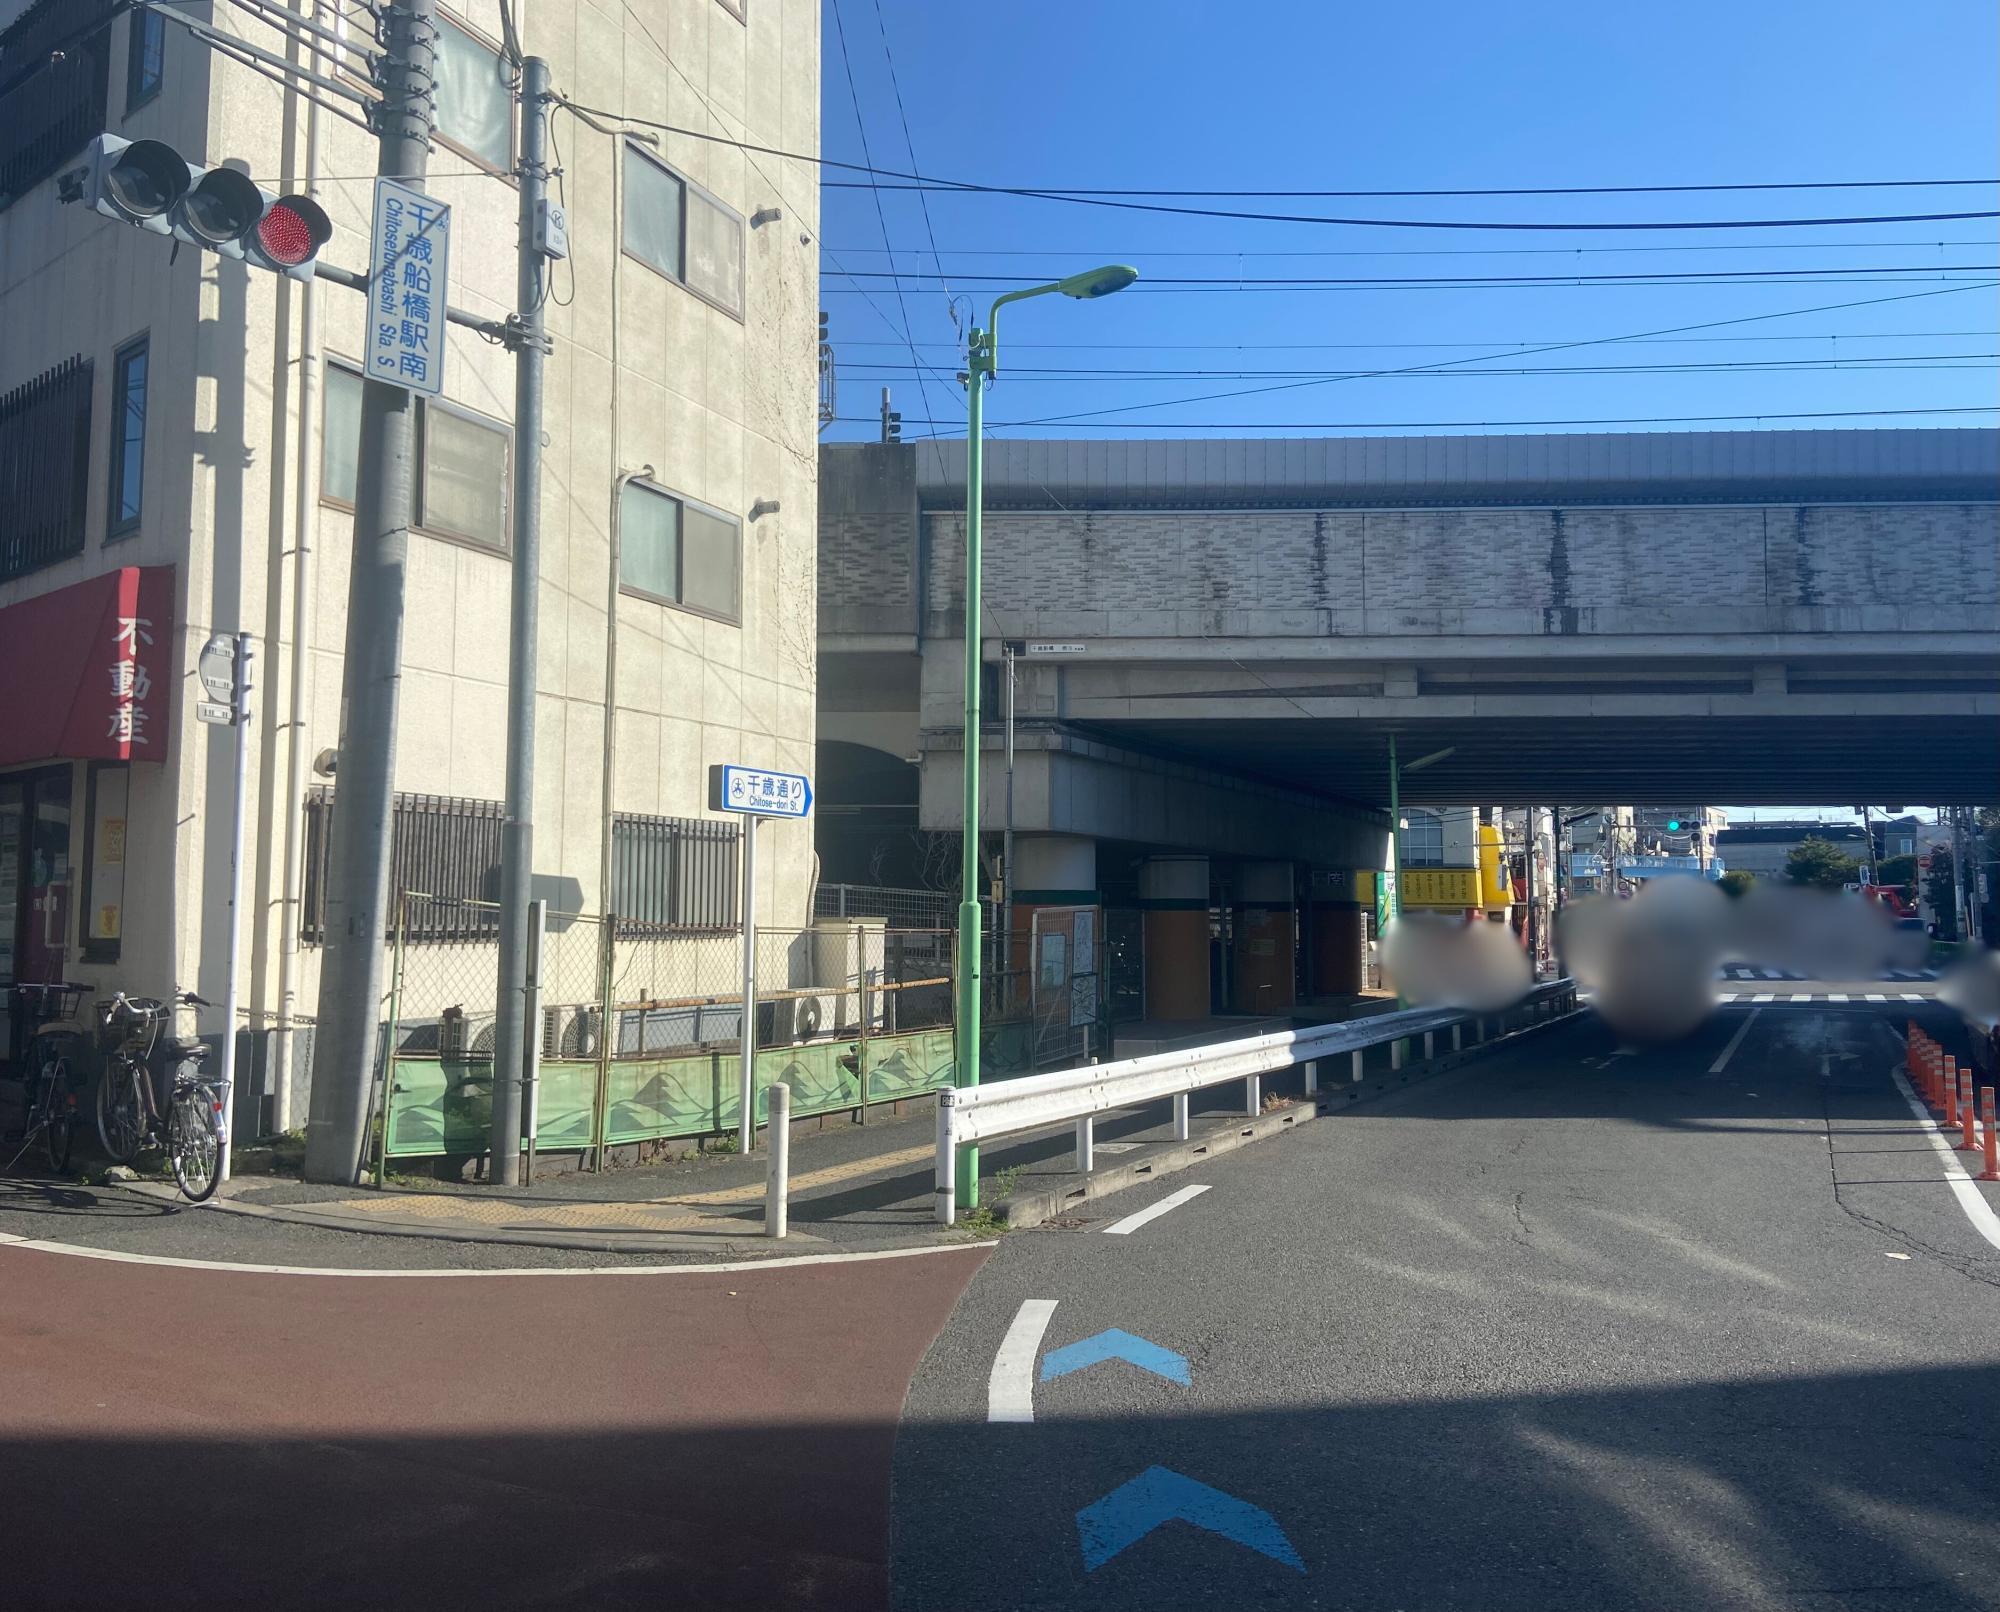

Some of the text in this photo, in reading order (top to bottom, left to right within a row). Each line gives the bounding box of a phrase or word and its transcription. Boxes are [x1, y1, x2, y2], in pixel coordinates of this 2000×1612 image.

[377, 198, 403, 369] Chitosefunabashi Sta. S.
[400, 202, 433, 382] 千歳船橋駅南
[107, 616, 154, 744] 不動産
[747, 775, 802, 799] 千歳通り
[749, 795, 799, 812] Chitose-dori St.
